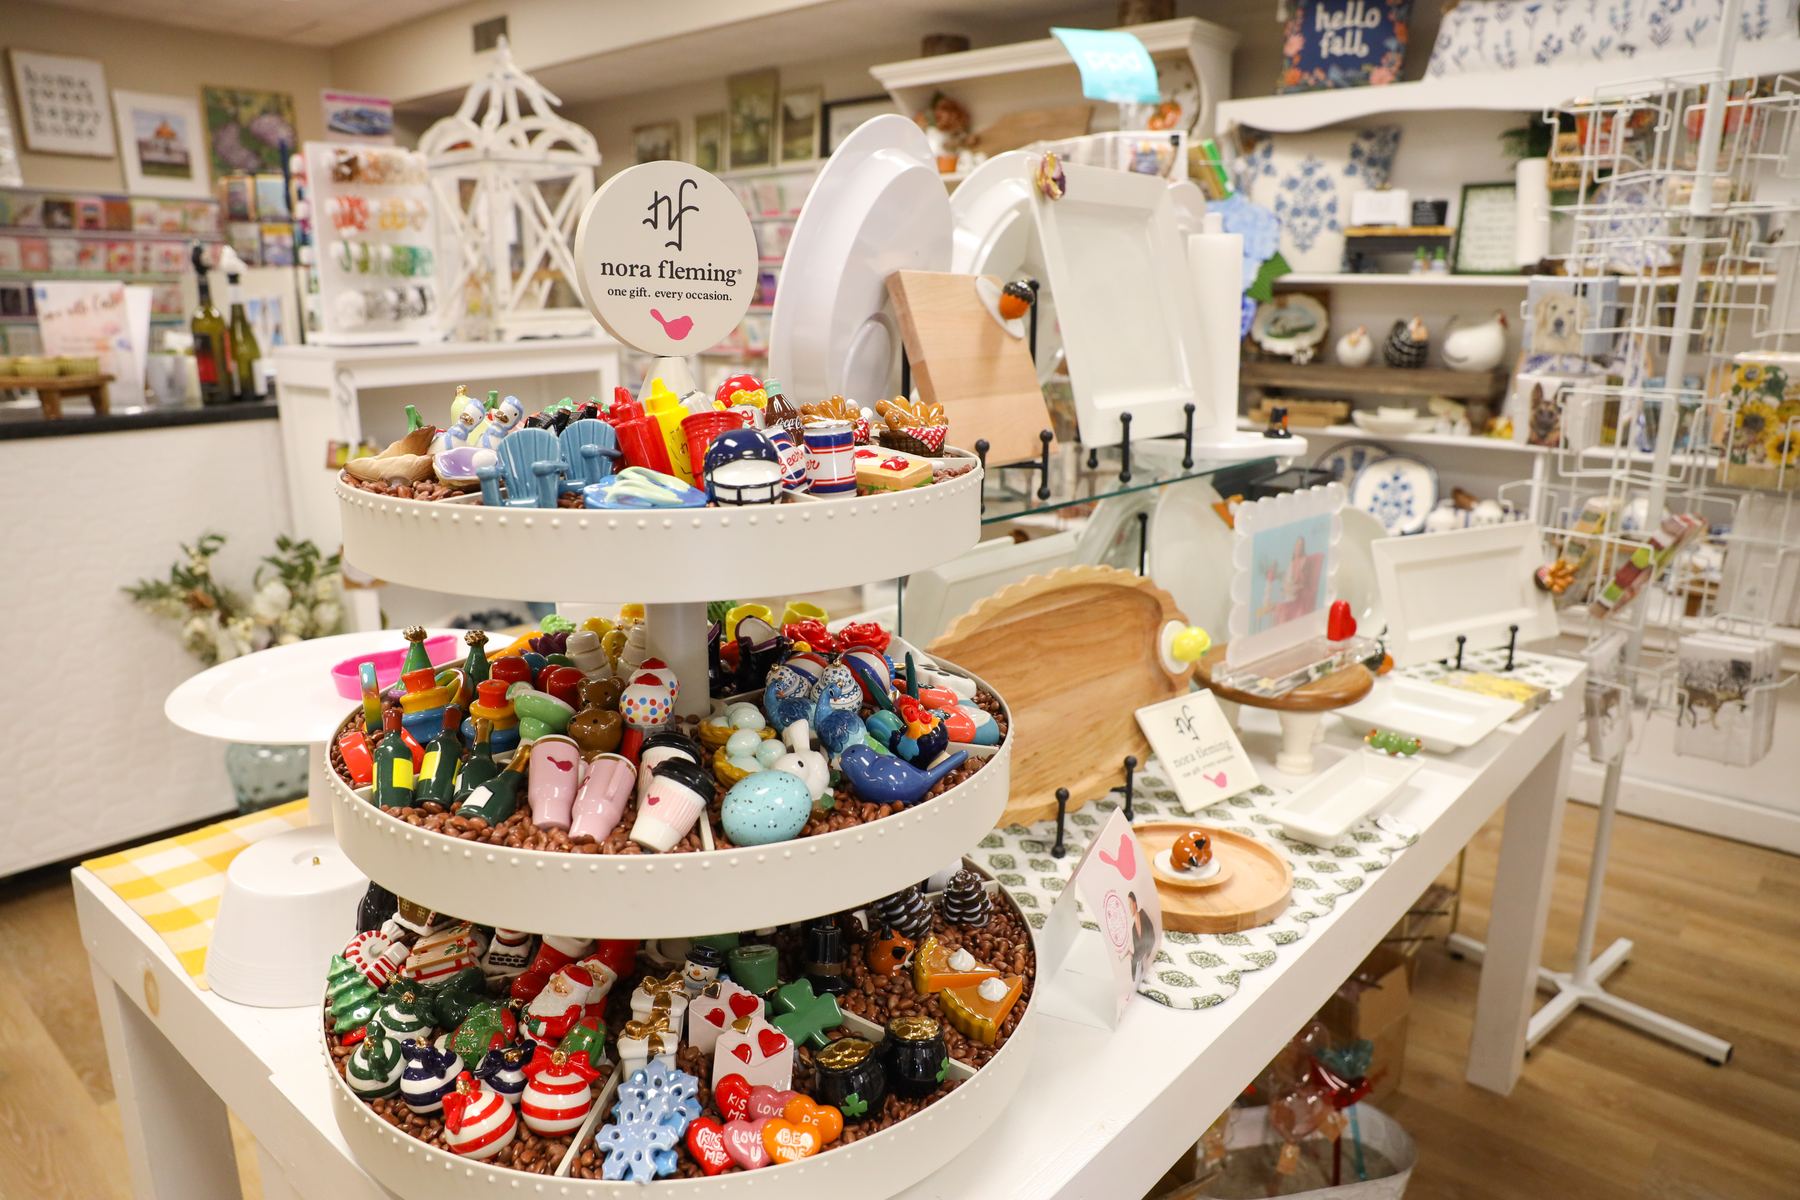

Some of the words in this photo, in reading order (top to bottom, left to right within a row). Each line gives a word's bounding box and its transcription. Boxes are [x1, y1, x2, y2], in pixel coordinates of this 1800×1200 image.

[1315, 0, 1381, 32] hello
[1319, 29, 1369, 59] fall
[600, 261, 651, 278] nora
[607, 288, 627, 298] one
[629, 286, 651, 299] gift.
[655, 290, 683, 301] every
[685, 290, 732, 301] occasion.
[728, 1109, 746, 1120] ME
[757, 1103, 784, 1118] LOVE
[732, 1130, 762, 1144] LOVE
[781, 1128, 802, 1145] BE
[750, 1146, 762, 1162] U
[776, 1146, 806, 1161] MINE
